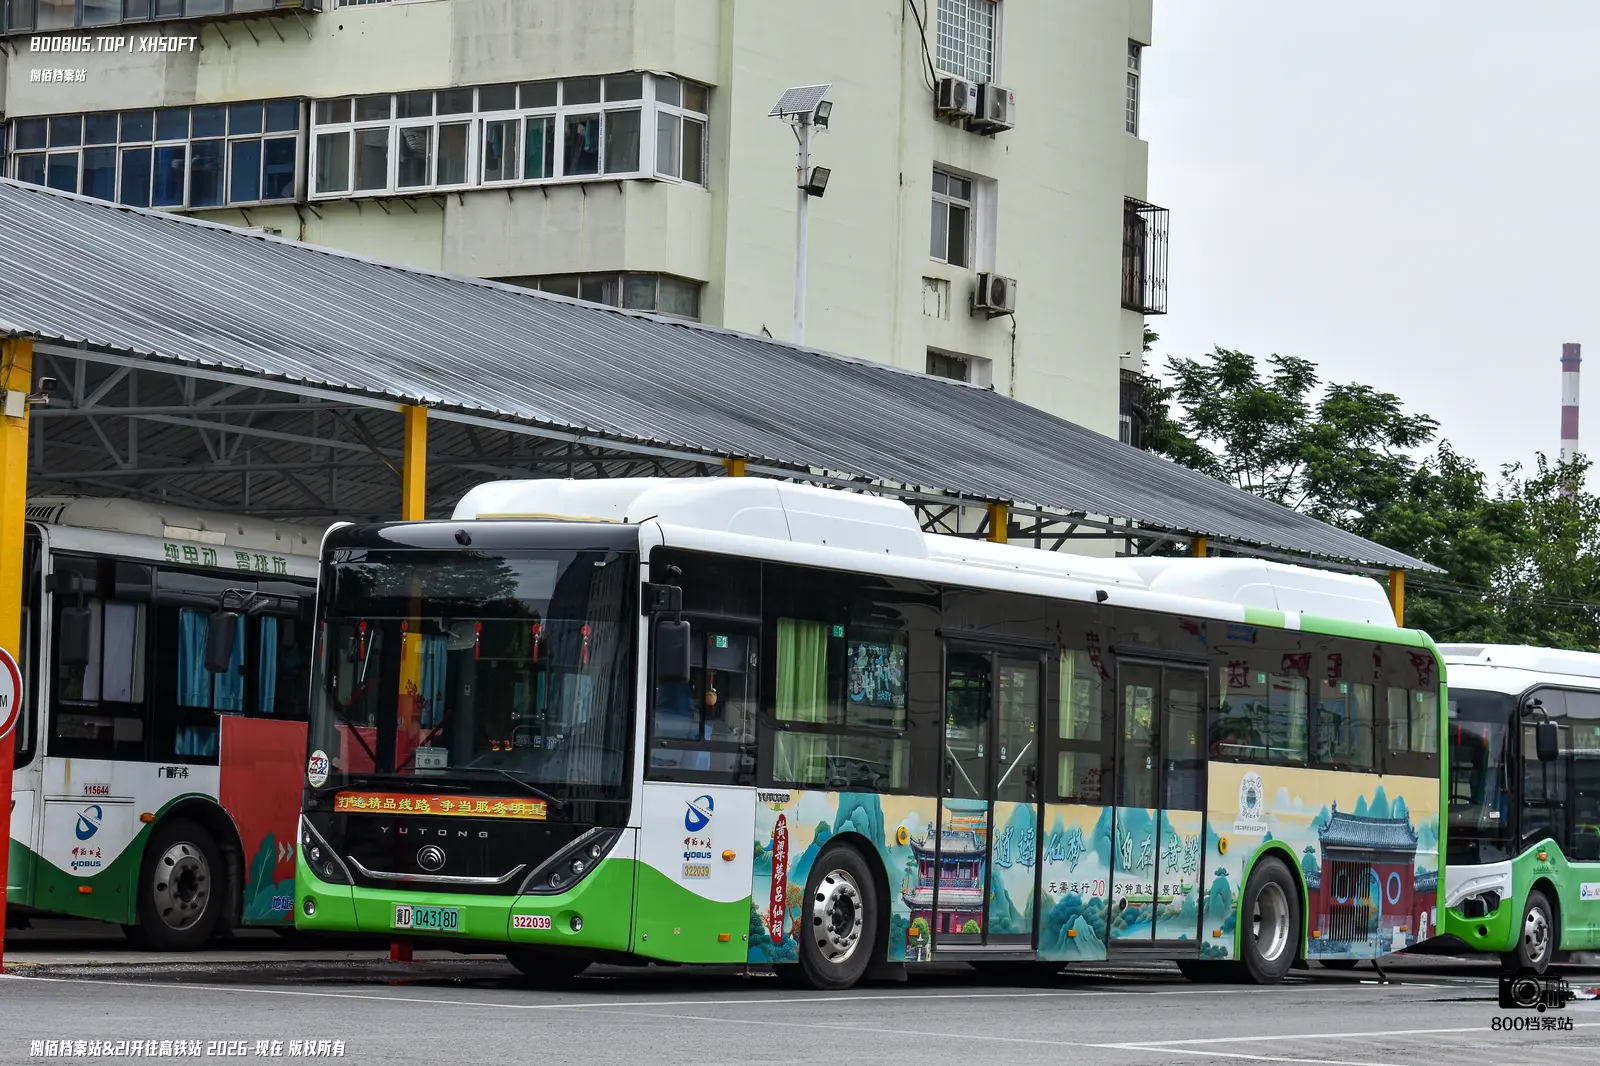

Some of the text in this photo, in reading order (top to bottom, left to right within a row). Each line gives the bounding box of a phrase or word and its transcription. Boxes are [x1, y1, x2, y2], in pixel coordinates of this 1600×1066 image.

[164, 543, 287, 575] 纯电动 零排放
[84, 786, 109, 795] 115644
[758, 792, 790, 803] YUTONG
[338, 796, 547, 816] 打造精品线路 争当服务明星
[381, 826, 489, 839] YUTONG
[684, 865, 710, 877] 322039
[514, 916, 551, 929] 322039
